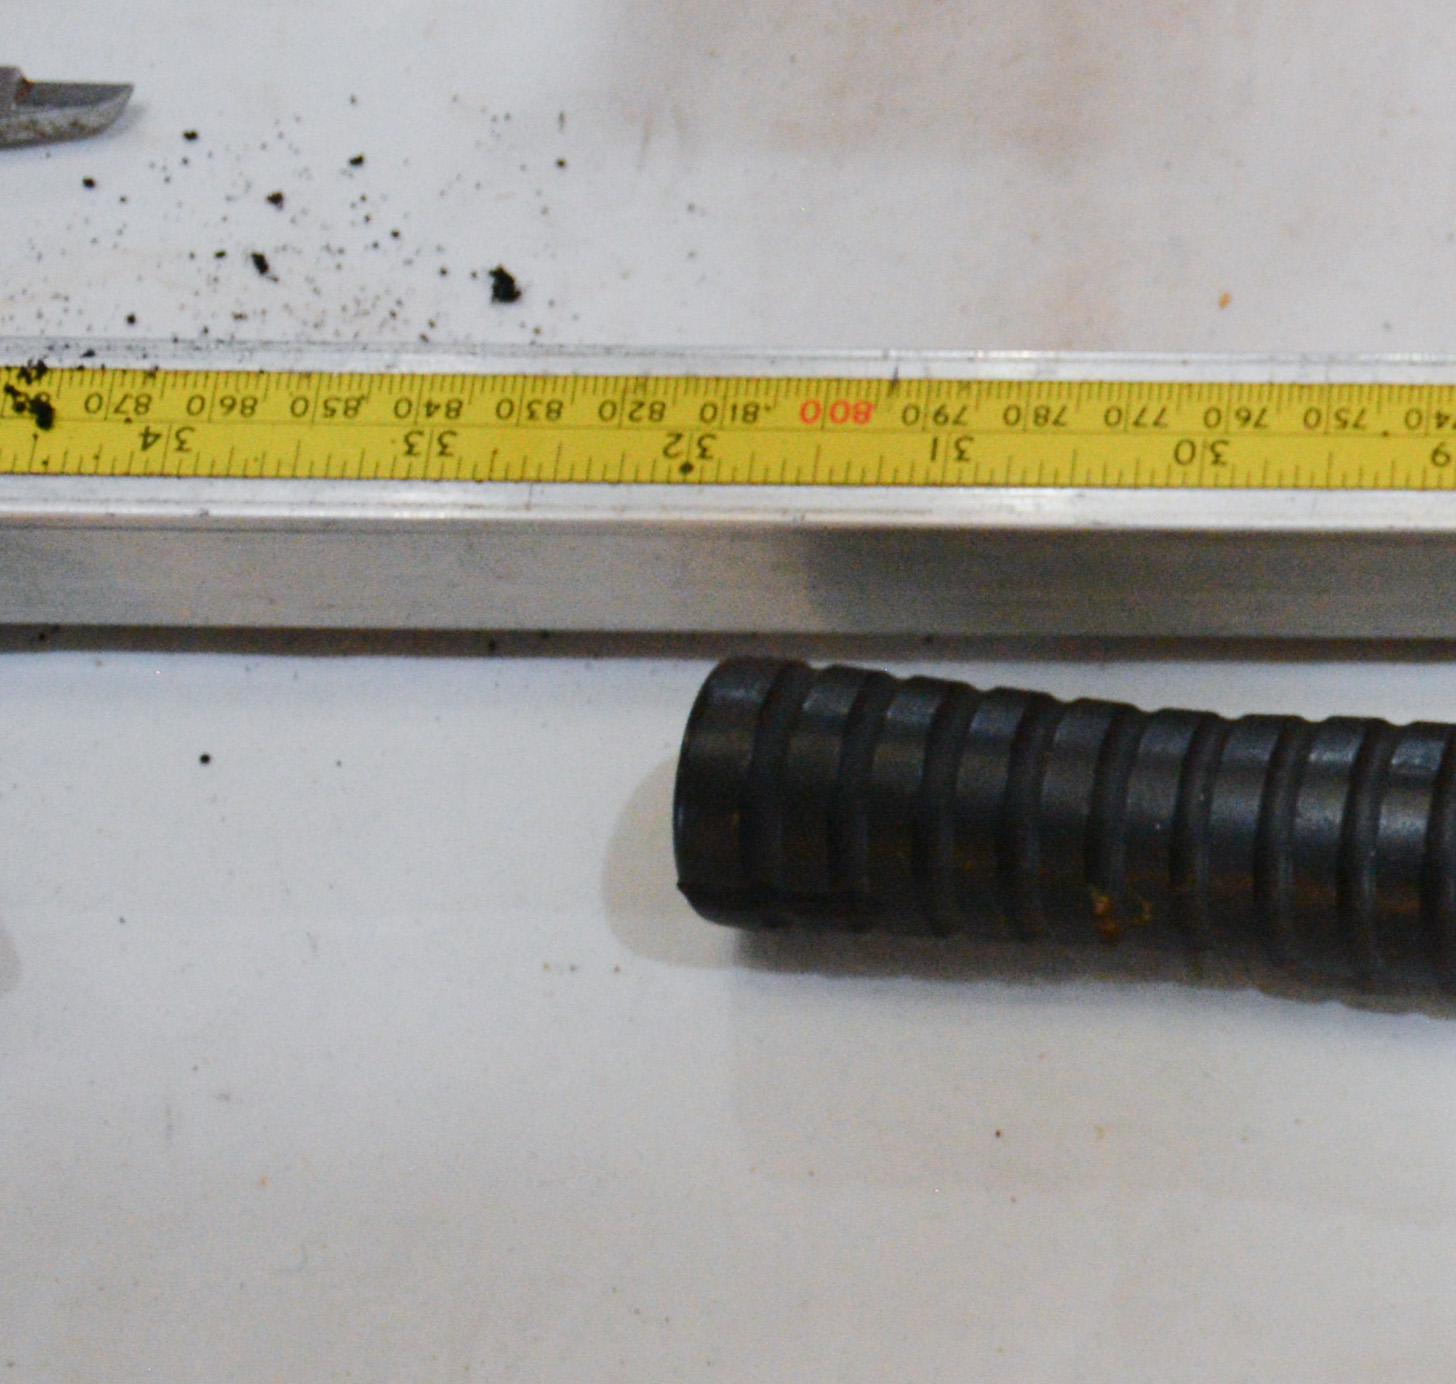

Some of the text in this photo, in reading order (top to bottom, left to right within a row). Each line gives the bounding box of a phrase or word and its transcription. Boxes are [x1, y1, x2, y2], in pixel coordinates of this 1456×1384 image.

[138, 426, 196, 454] 34
[402, 429, 458, 457] 33
[662, 432, 717, 461] 32
[929, 435, 976, 463] 31
[1172, 438, 1231, 467] 30
